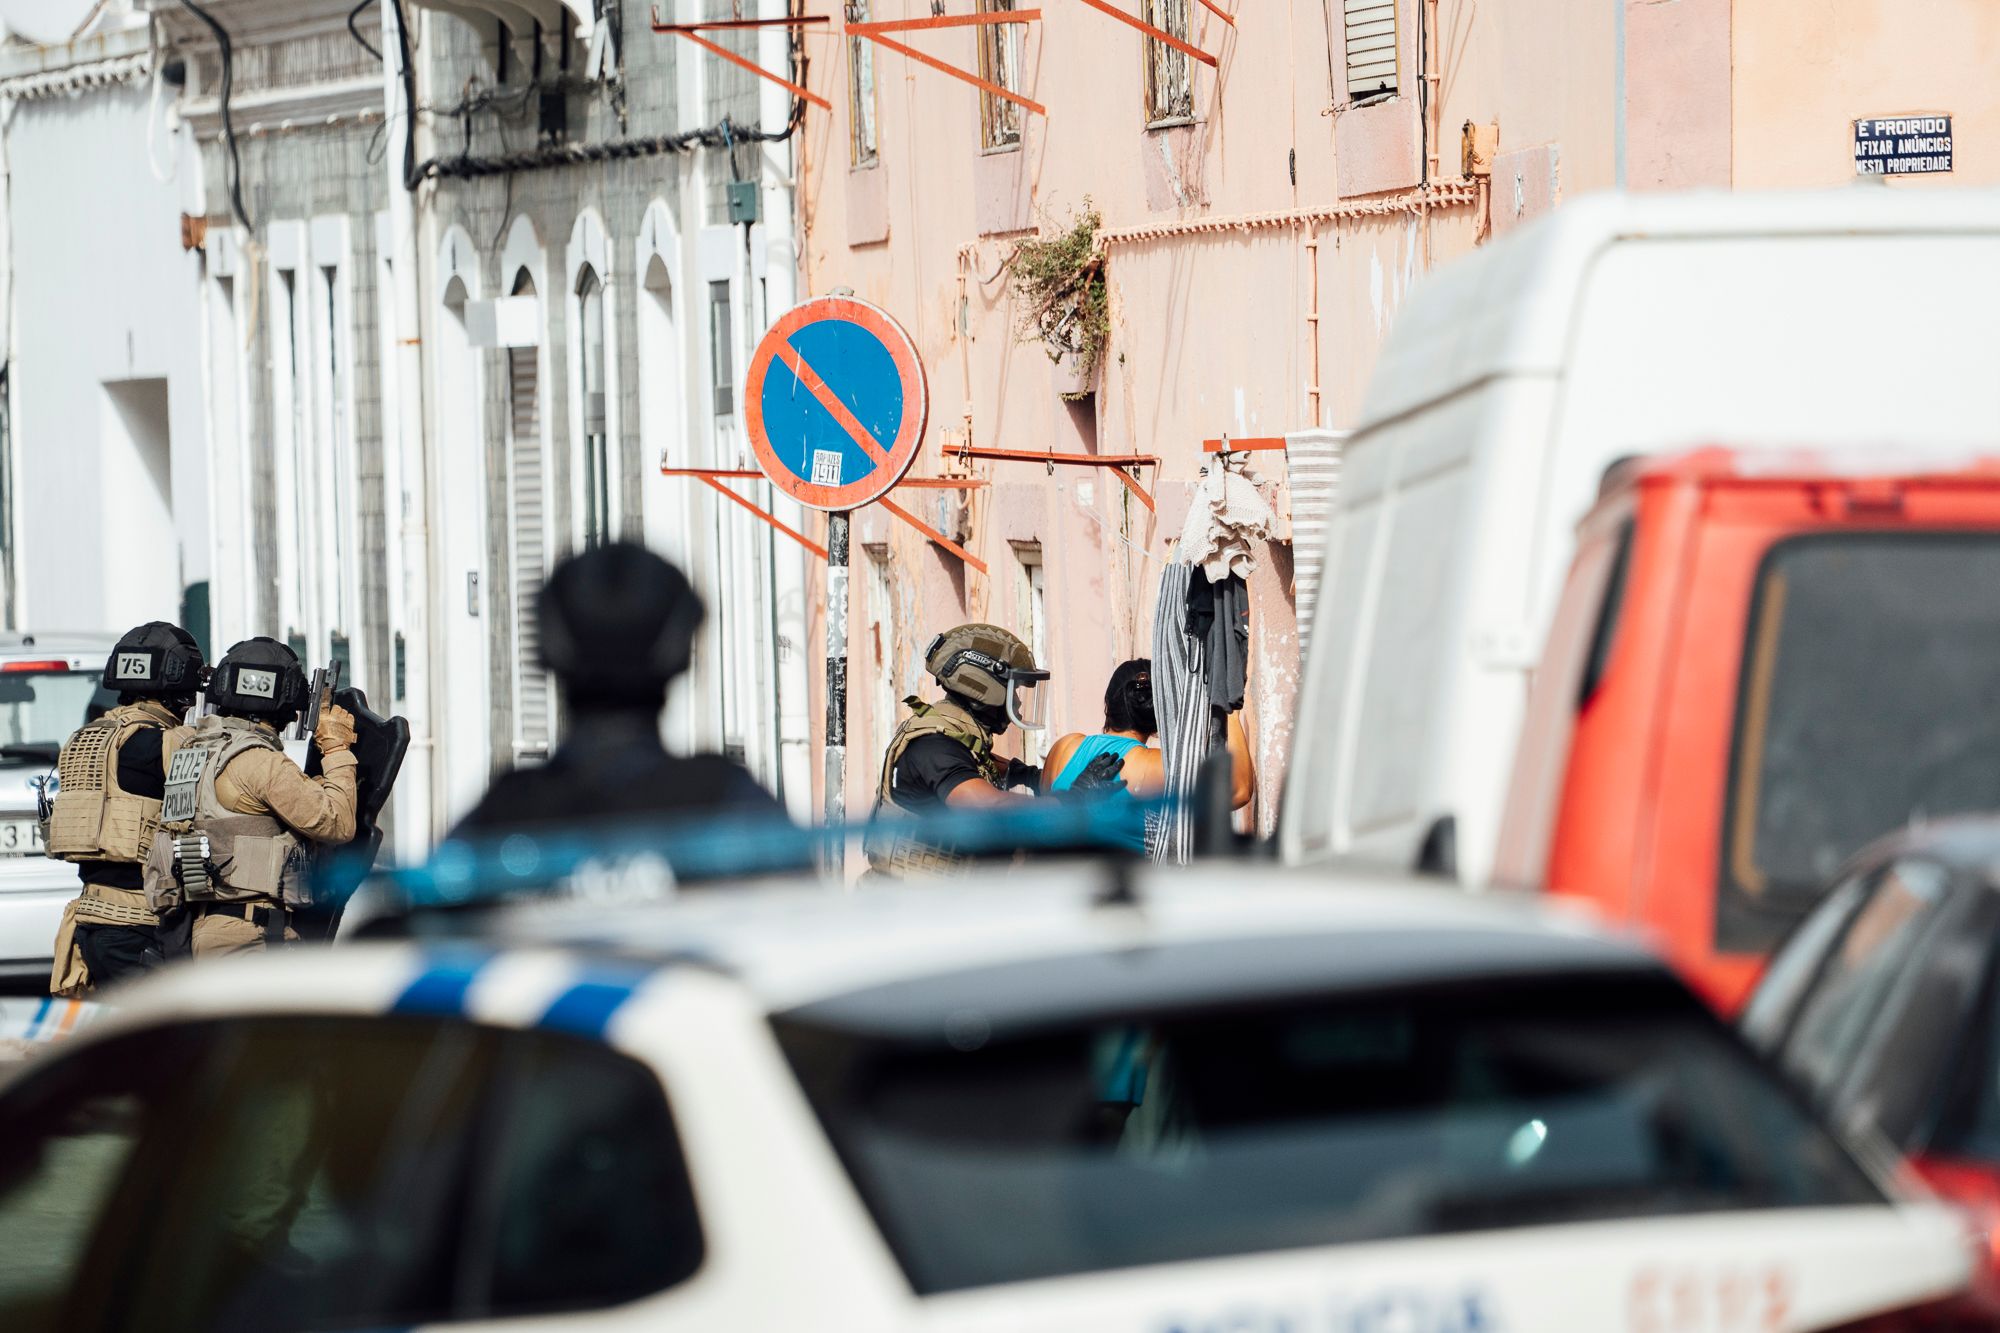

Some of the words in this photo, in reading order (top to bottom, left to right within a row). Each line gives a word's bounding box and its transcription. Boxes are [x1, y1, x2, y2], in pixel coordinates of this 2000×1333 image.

[1875, 119, 1947, 137] PROIBIDO
[1855, 139, 1894, 156] AFIXAR
[1898, 135, 1952, 154] ANÚNCIOS
[1856, 159, 1885, 174] NESTA
[1887, 156, 1951, 173] PROPRIEDADE
[813, 463, 840, 484] 1911
[121, 658, 145, 674] 75
[242, 674, 270, 693] 96
[168, 752, 206, 781] GOE
